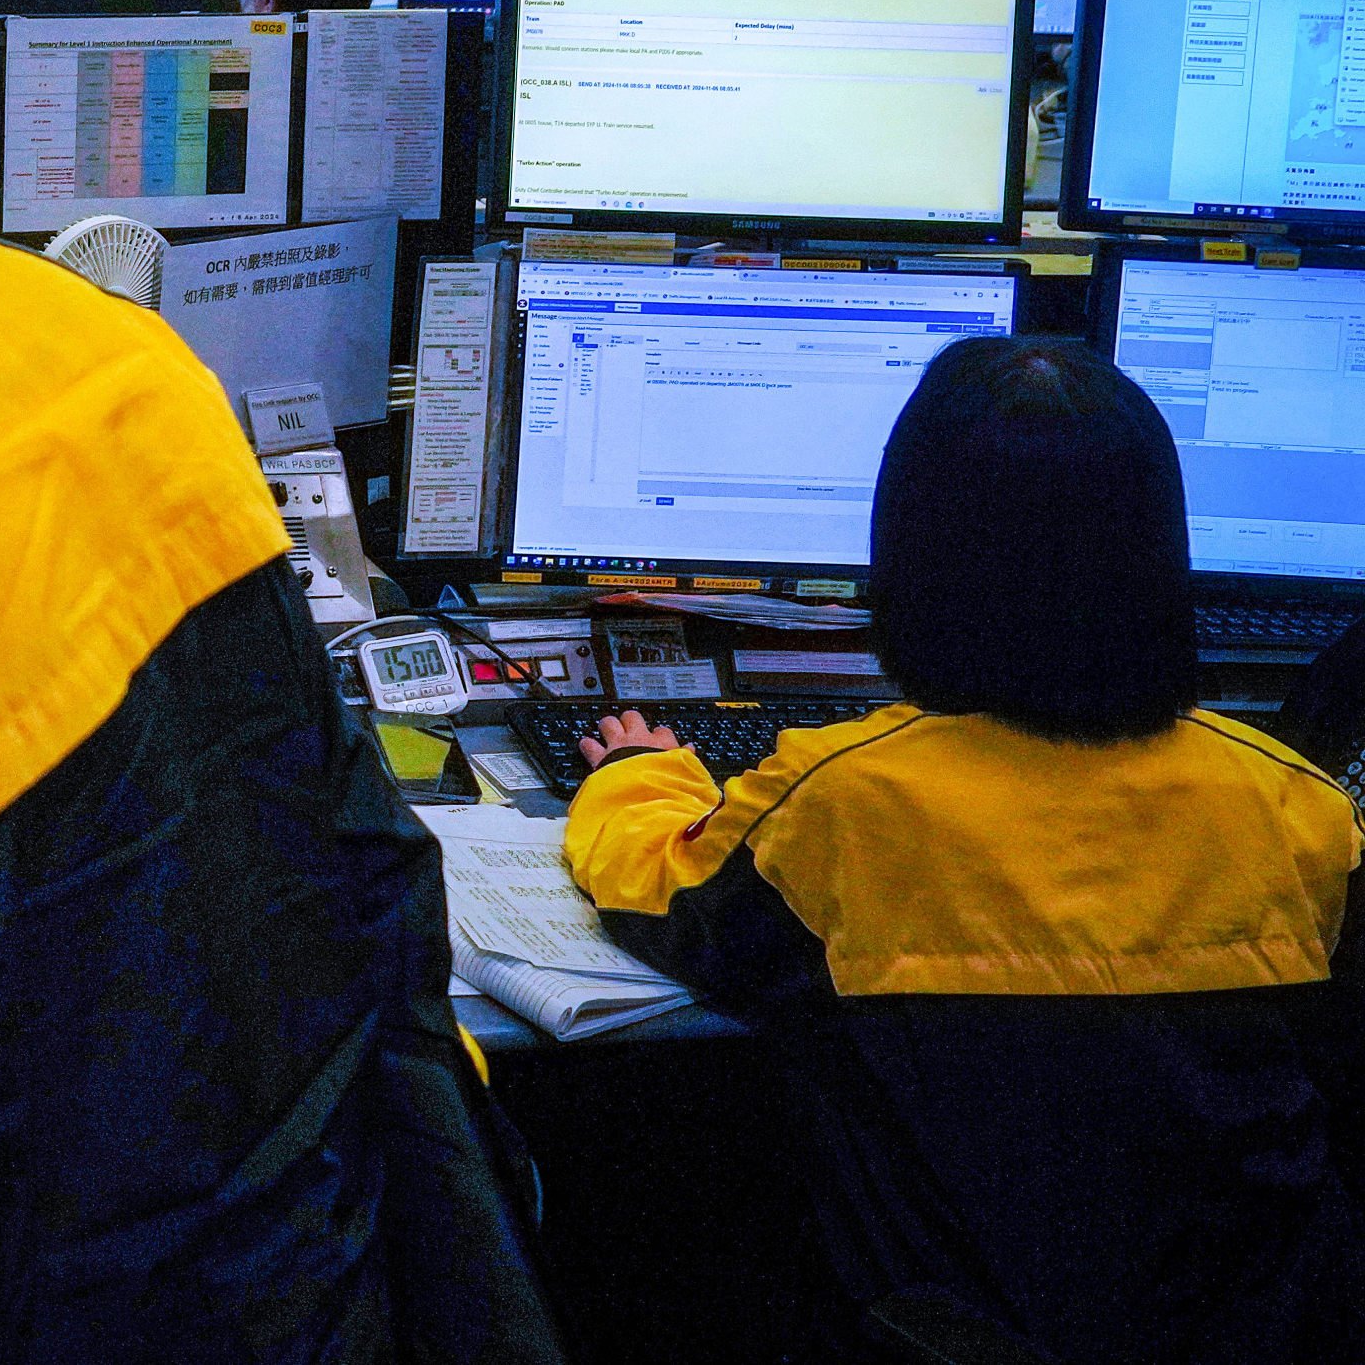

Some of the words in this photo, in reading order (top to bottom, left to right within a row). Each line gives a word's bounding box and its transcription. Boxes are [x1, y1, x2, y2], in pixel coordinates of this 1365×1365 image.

[254, 24, 282, 32] COC3
[206, 259, 231, 274] OCR
[278, 412, 306, 431] NIL
[266, 461, 288, 470] WRL
[292, 460, 313, 469] PAS
[314, 459, 336, 468] BCP
[405, 701, 437, 713] CCC
